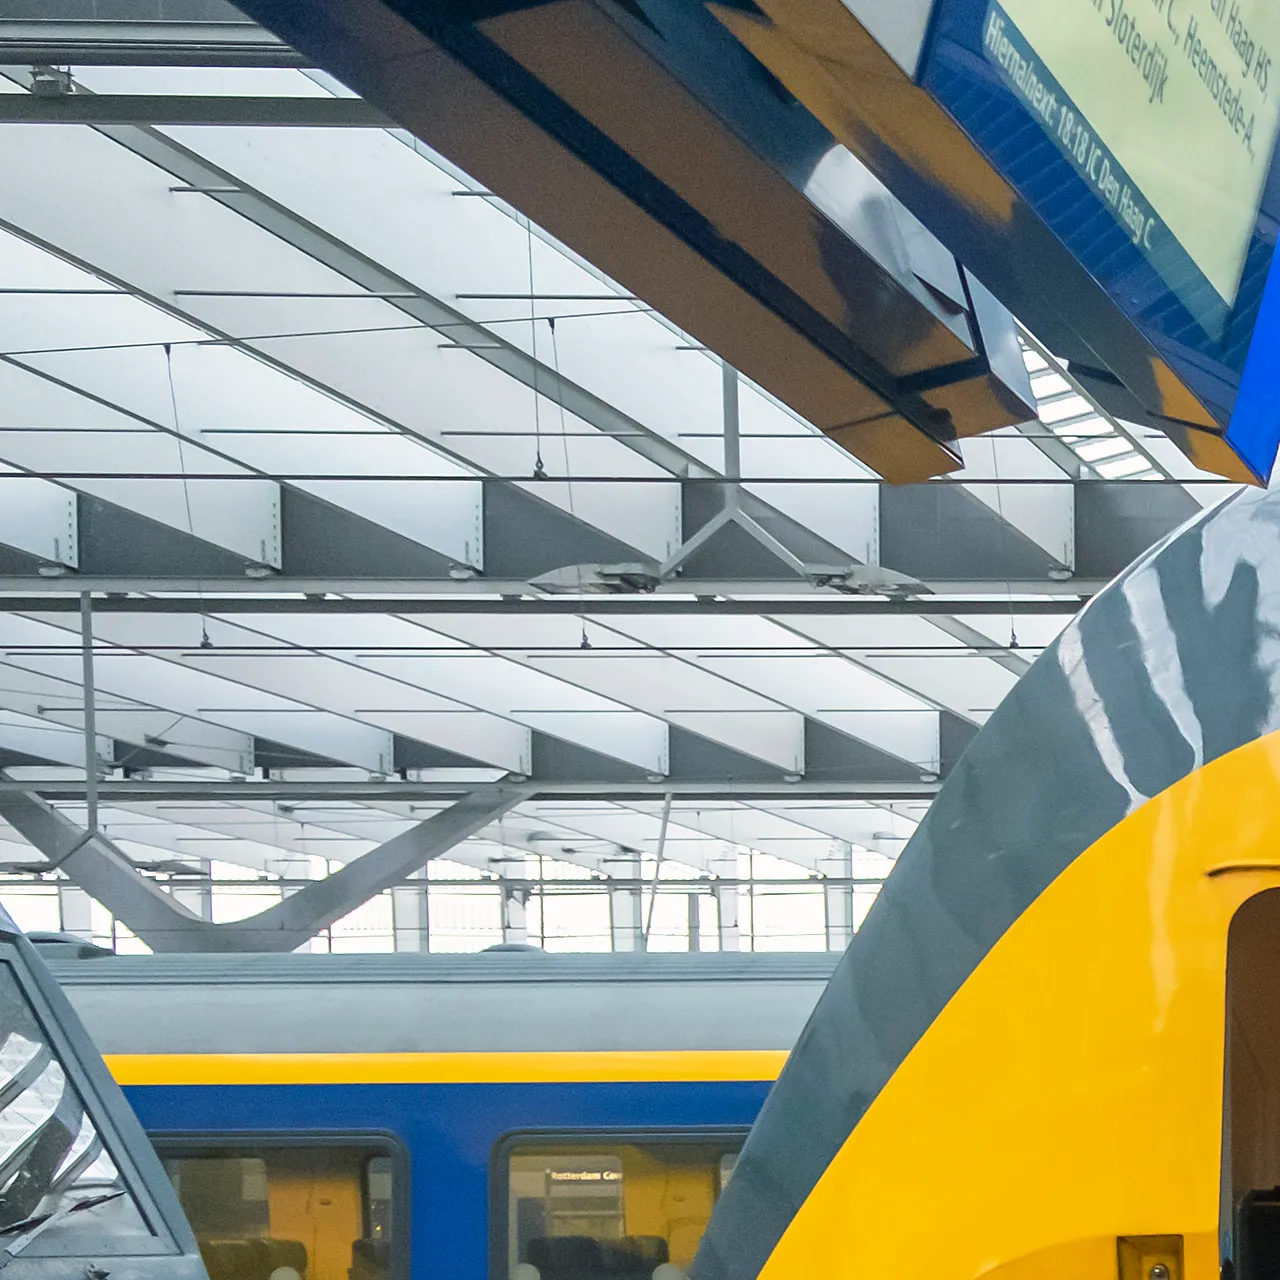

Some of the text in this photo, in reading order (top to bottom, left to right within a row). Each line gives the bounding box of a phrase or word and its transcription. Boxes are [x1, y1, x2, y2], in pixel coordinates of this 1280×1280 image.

[1105, 0, 1168, 105] Sloterdijk
[1225, 0, 1255, 79] Haag
[1057, 105, 1089, 165] 18:18
[1085, 142, 1102, 181] IC
[1098, 157, 1120, 208] Den
[1118, 184, 1145, 245] Haag
[1143, 217, 1155, 251] C
[551, 1170, 601, 1181] Rotterdam
